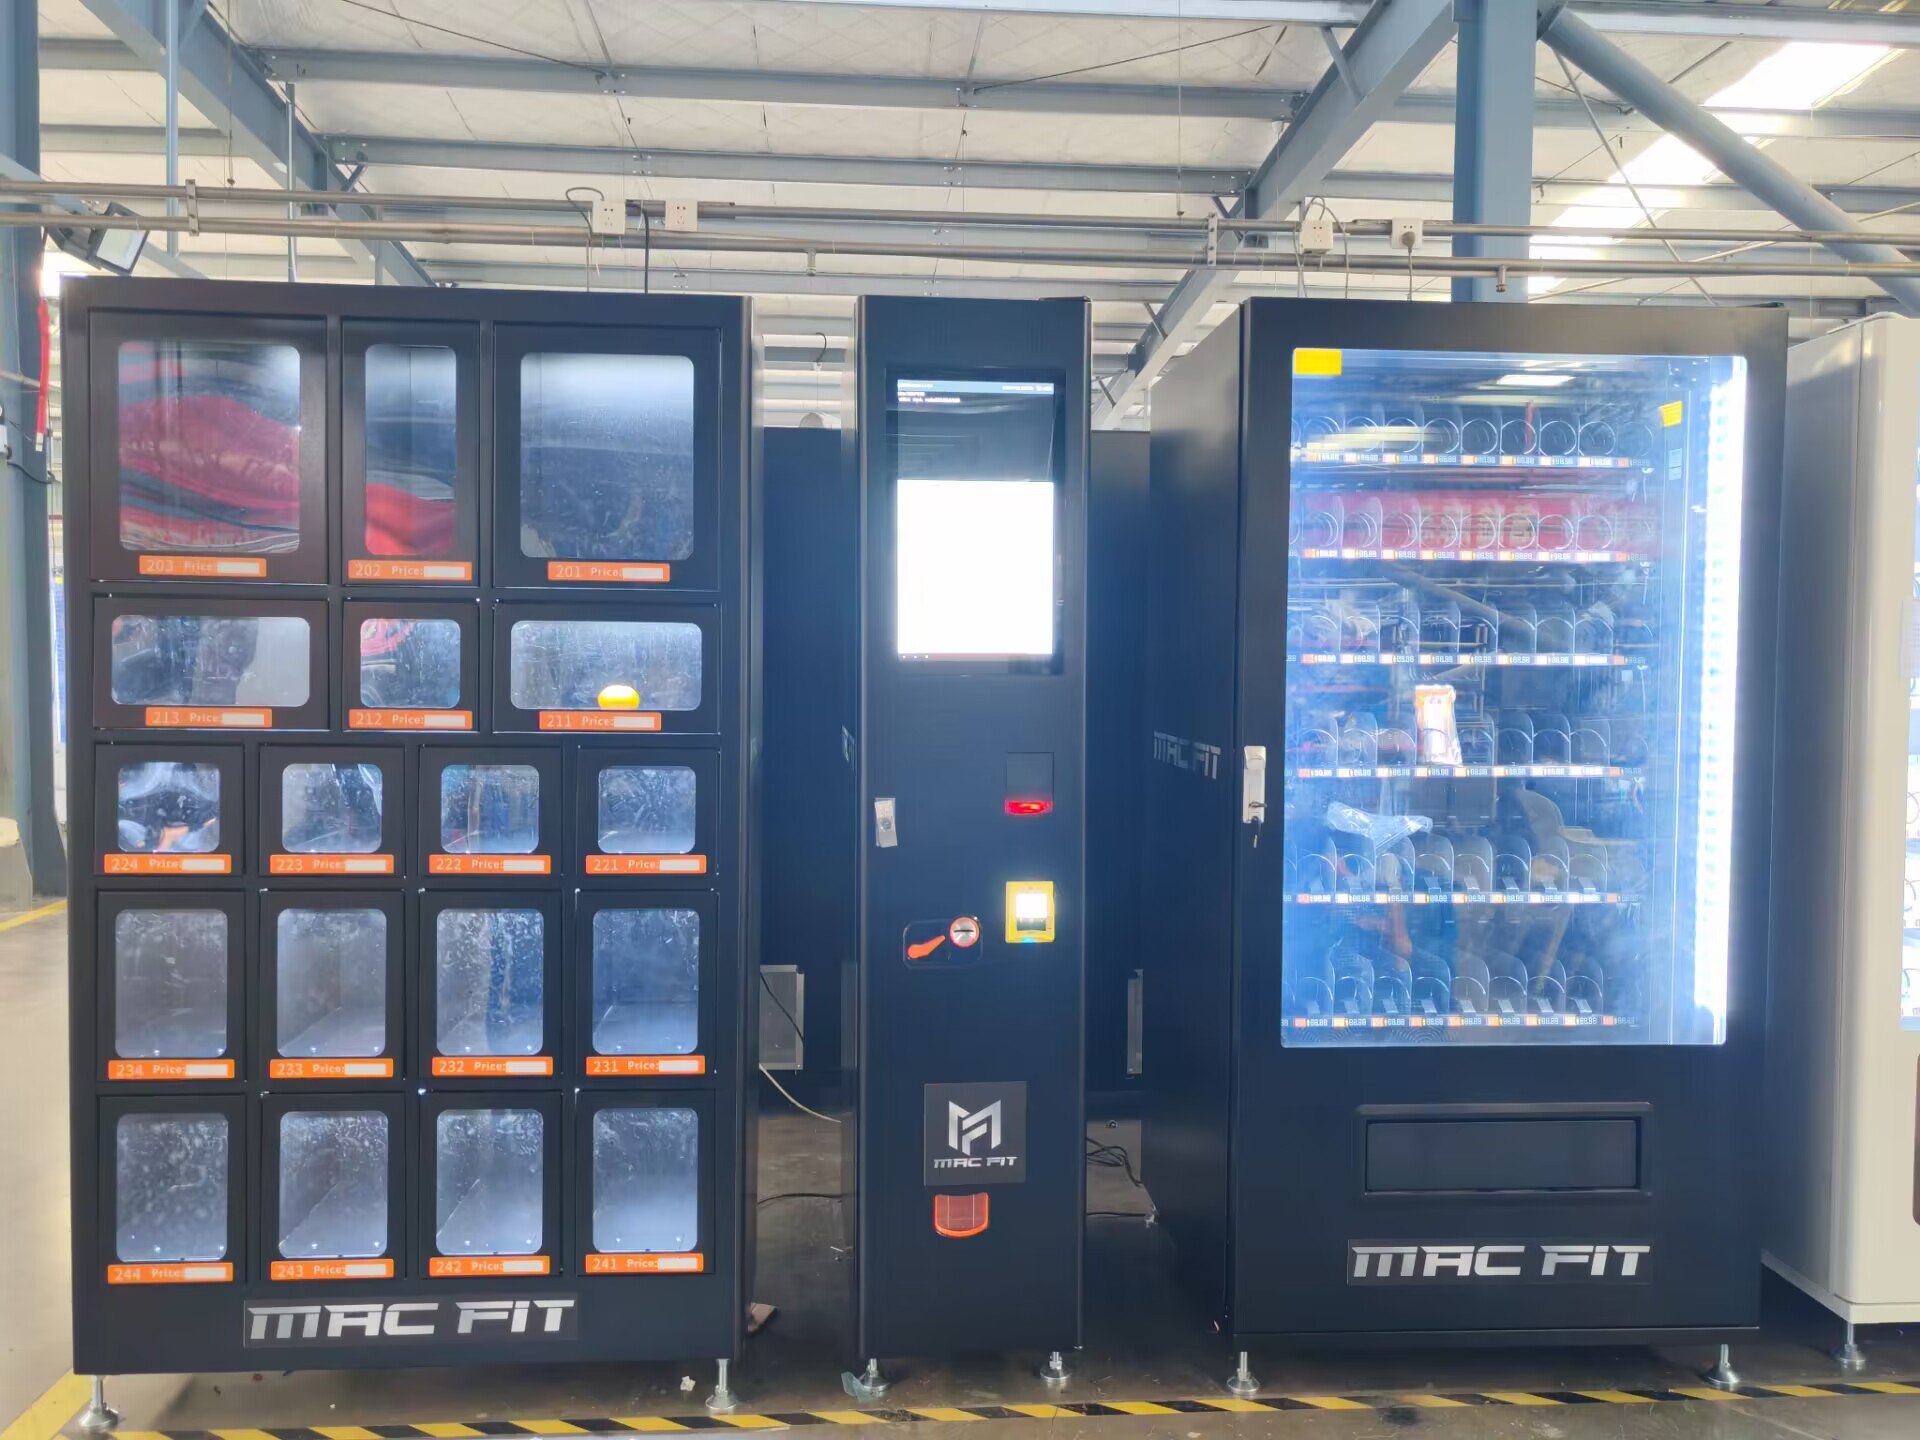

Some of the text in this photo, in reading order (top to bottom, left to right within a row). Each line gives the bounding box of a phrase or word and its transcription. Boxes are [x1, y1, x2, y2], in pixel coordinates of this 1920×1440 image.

[147, 559, 173, 572] 203
[356, 564, 381, 577] 202
[556, 565, 581, 577] 201
[153, 710, 179, 723] 213
[356, 713, 381, 725] 212
[547, 715, 571, 727] 211
[112, 858, 138, 871] 224
[277, 858, 303, 871] 223
[436, 857, 462, 870] 222
[593, 859, 618, 871] 221
[117, 1064, 144, 1077] 234
[277, 1063, 303, 1075] 233
[439, 1061, 465, 1073] 232
[593, 1060, 618, 1072] 231
[934, 1156, 1018, 1168] MAC FIT
[436, 1260, 462, 1273] 242
[592, 1258, 617, 1270] 241
[1352, 1245, 1650, 1277] MAC FIT
[115, 1267, 141, 1280] 244
[278, 1264, 304, 1277] 243
[248, 1299, 575, 1339] MAC FIT
